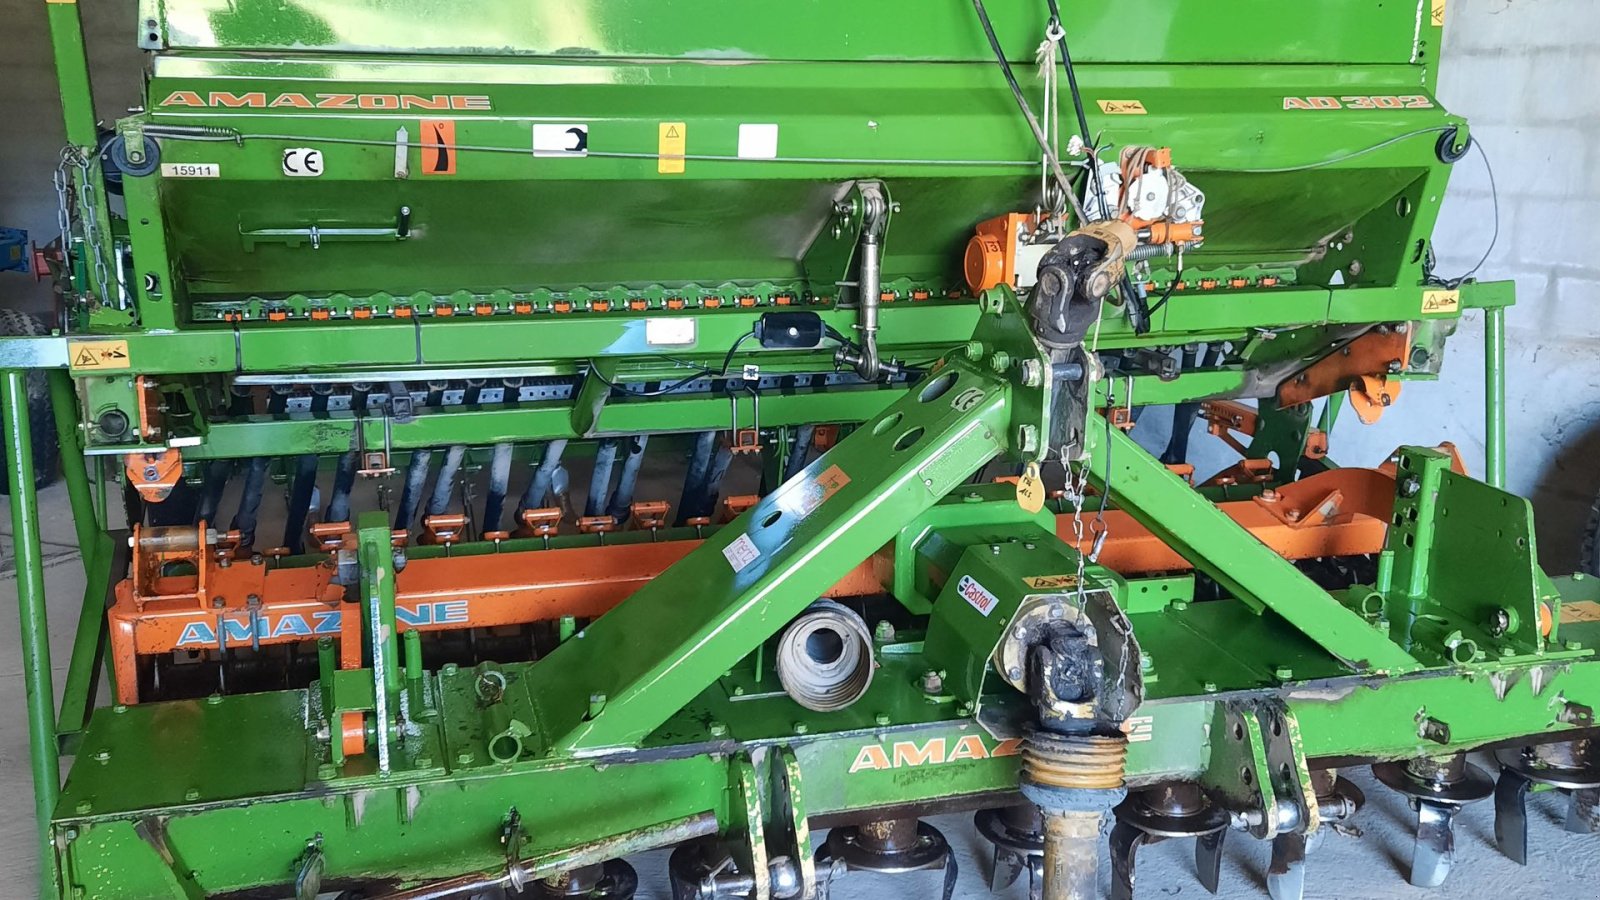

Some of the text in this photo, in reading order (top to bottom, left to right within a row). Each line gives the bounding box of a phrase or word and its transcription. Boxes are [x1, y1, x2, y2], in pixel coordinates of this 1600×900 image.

[159, 91, 492, 110] AMAZONE
[1283, 95, 1434, 110] AD 302
[171, 166, 212, 176] 15911
[964, 582, 992, 612] Castrol
[176, 600, 469, 646] AMAZNE
